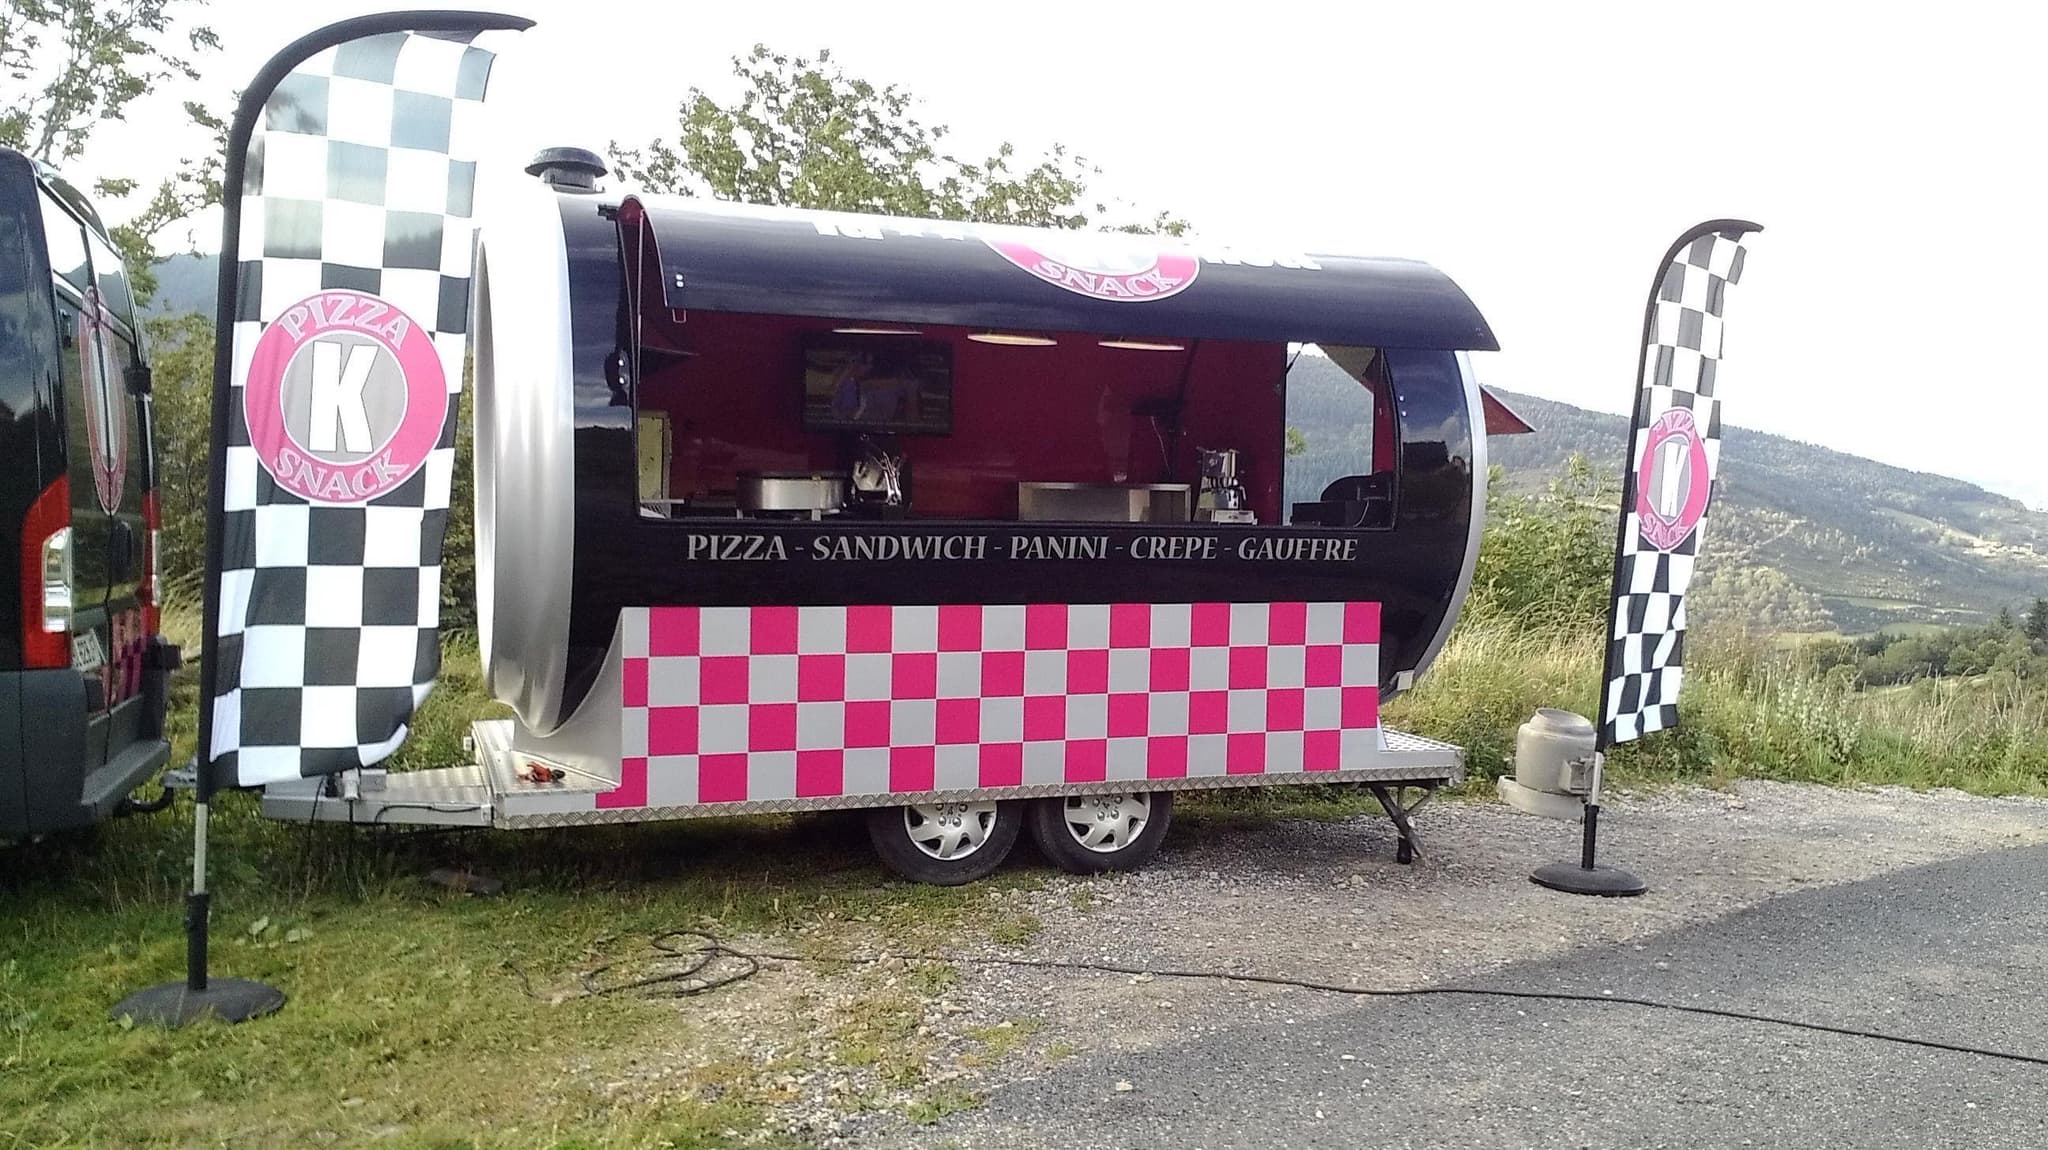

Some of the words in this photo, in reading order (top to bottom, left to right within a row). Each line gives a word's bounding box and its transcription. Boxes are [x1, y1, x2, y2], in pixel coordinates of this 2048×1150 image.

[1033, 260, 1182, 297] SNACK
[277, 295, 411, 350] PIZZA
[308, 341, 380, 453] K
[273, 447, 409, 499] SNACK
[686, 534, 789, 561] PIZZA
[811, 534, 987, 561] SANDWICH
[1010, 535, 1109, 560] PANINI
[1130, 536, 1218, 560] CREPE
[1238, 536, 1359, 561] GAUFFRE
